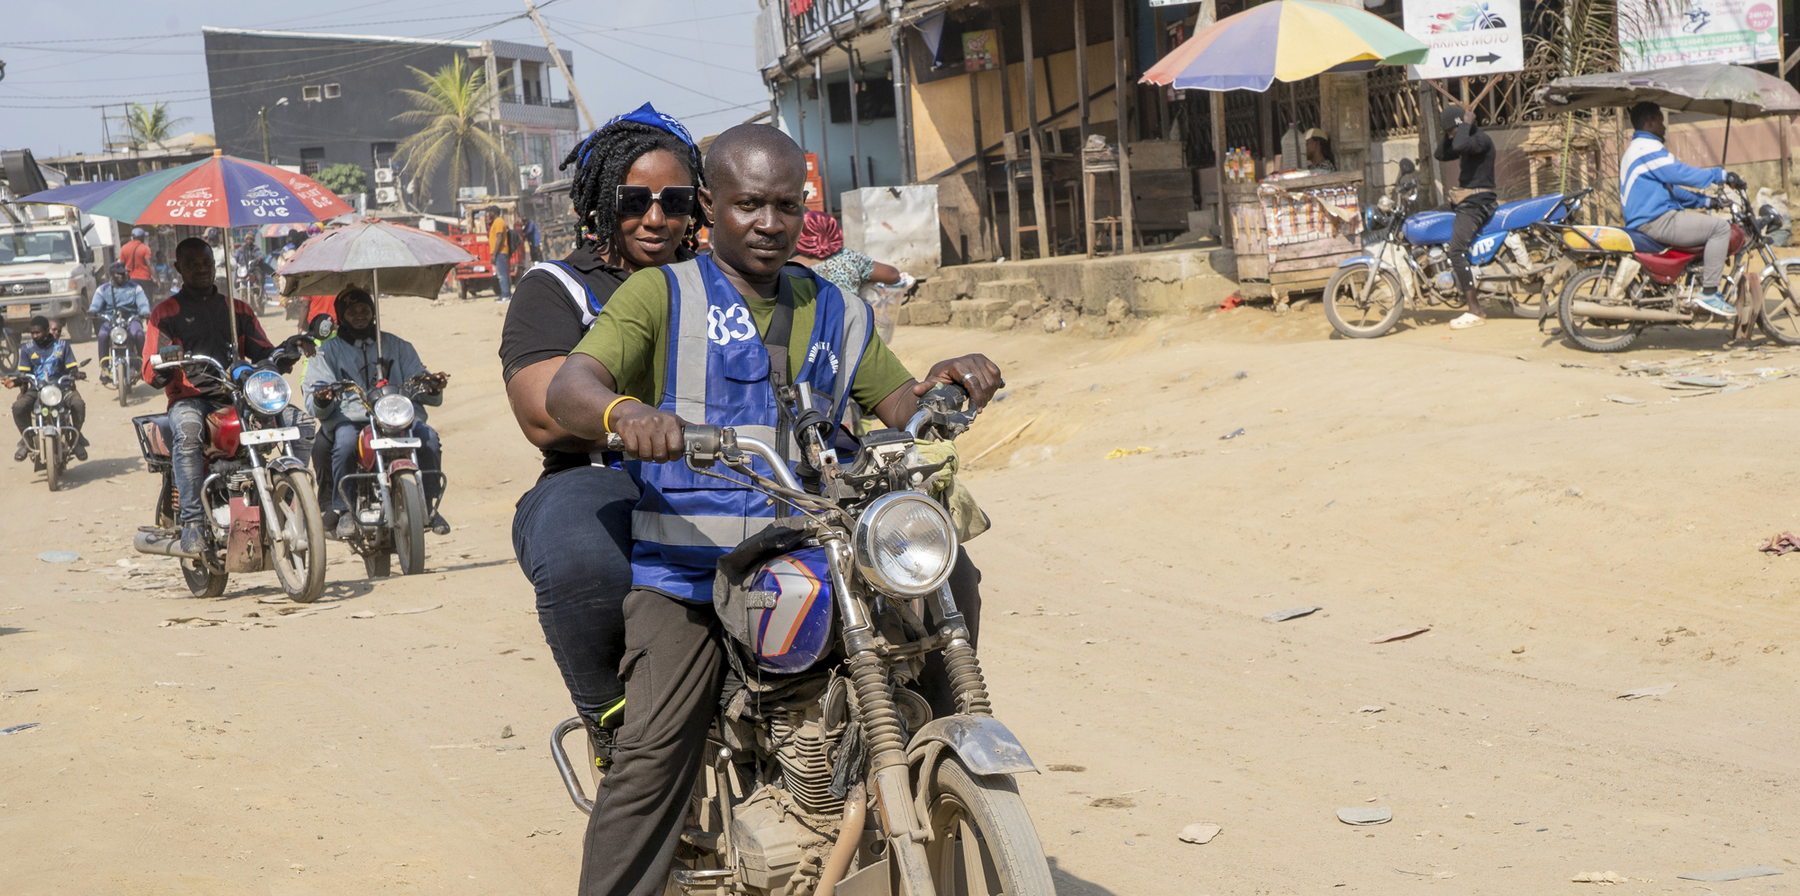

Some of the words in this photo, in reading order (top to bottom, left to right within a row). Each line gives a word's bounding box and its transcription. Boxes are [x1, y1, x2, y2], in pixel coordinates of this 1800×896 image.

[1472, 32, 1509, 46] MOTO
[1442, 54, 1475, 68] VIP
[1655, 47, 1750, 63] DENTISTE
[1469, 237, 1495, 257] VIP
[707, 303, 756, 345] 83
